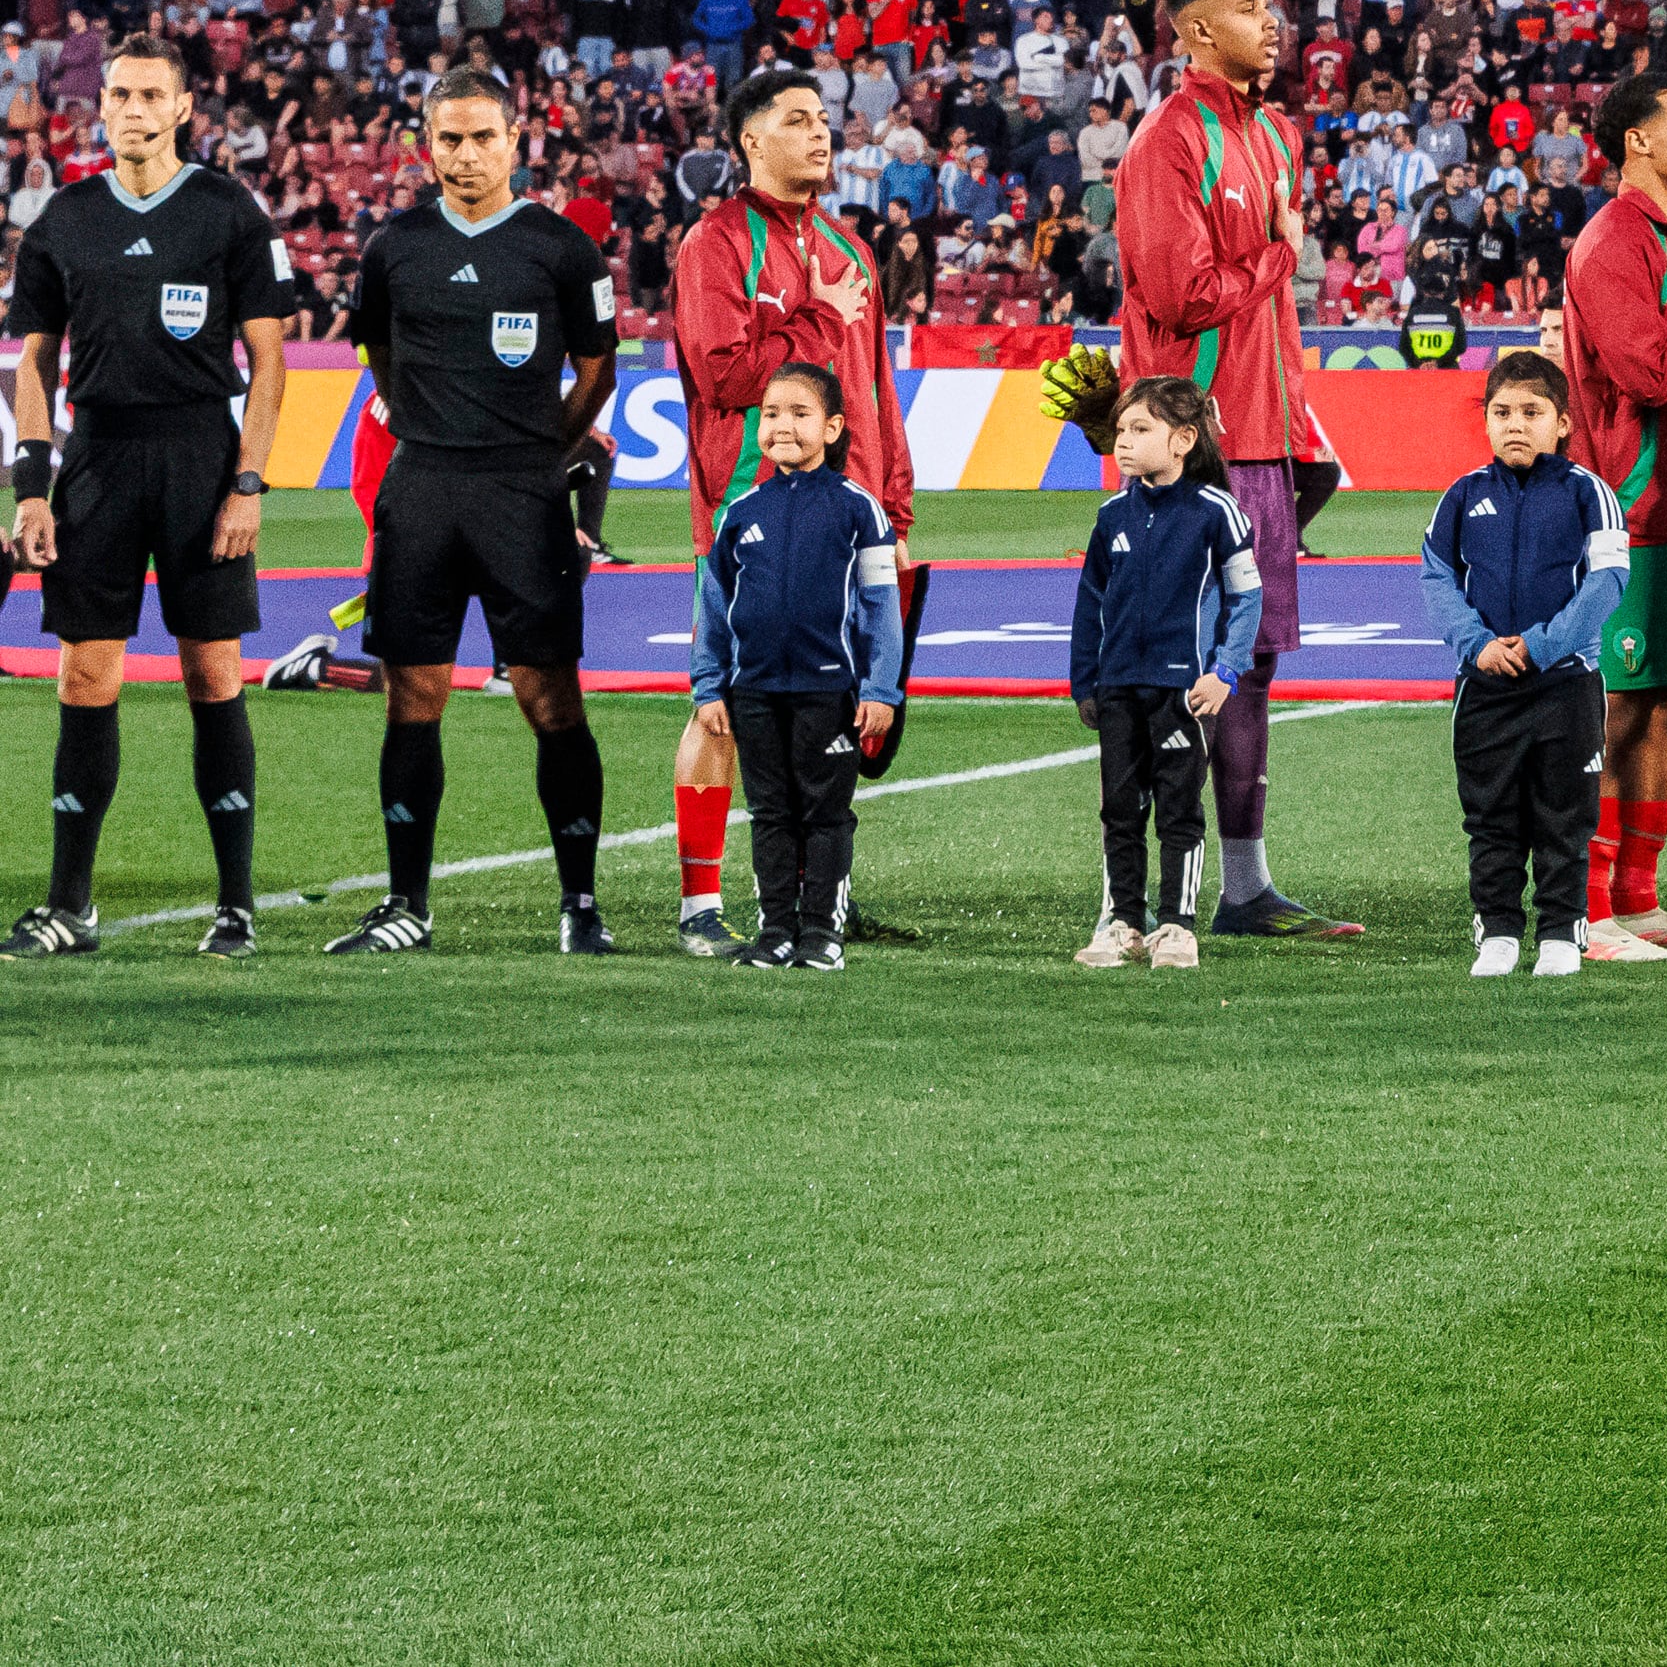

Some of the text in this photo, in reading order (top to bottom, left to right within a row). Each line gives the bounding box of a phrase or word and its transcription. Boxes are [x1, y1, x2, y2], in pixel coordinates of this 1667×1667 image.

[167, 288, 202, 302] FIFA
[497, 316, 533, 330] FIFA
[1419, 334, 1442, 349] 710
